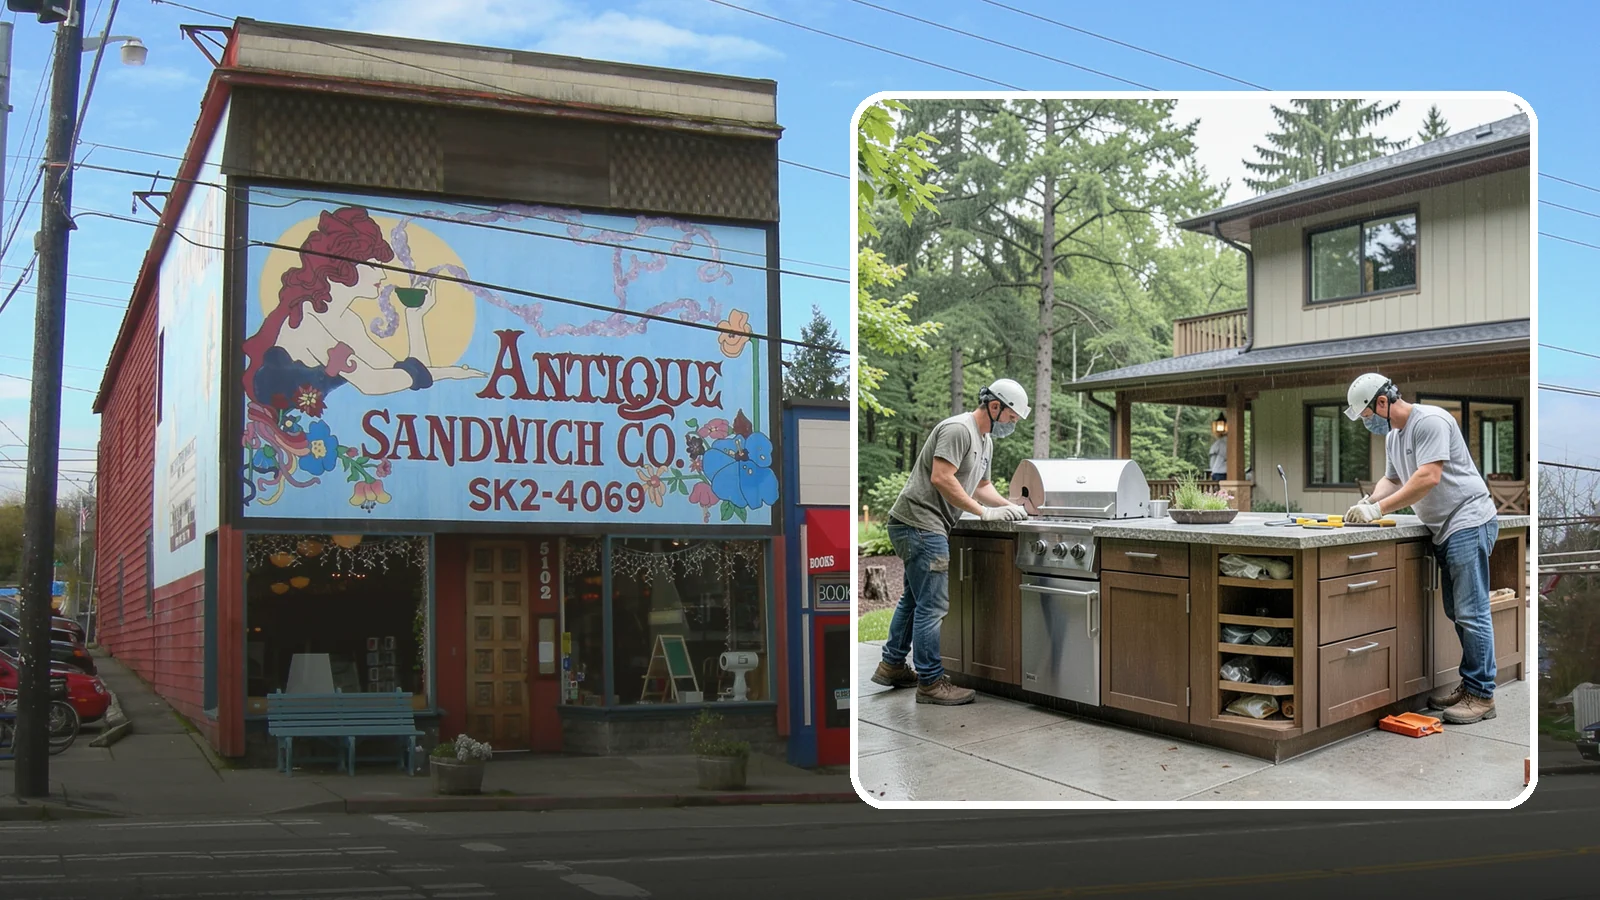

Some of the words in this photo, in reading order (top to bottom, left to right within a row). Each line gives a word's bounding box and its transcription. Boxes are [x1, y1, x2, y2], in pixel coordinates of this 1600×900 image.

[476, 329, 723, 420] ANTIQUE
[361, 408, 604, 467] SANDWICH
[617, 422, 685, 469] CO.
[468, 477, 645, 513] SK2-4069
[539, 542, 551, 600] 5102
[809, 555, 835, 569] BOOKS
